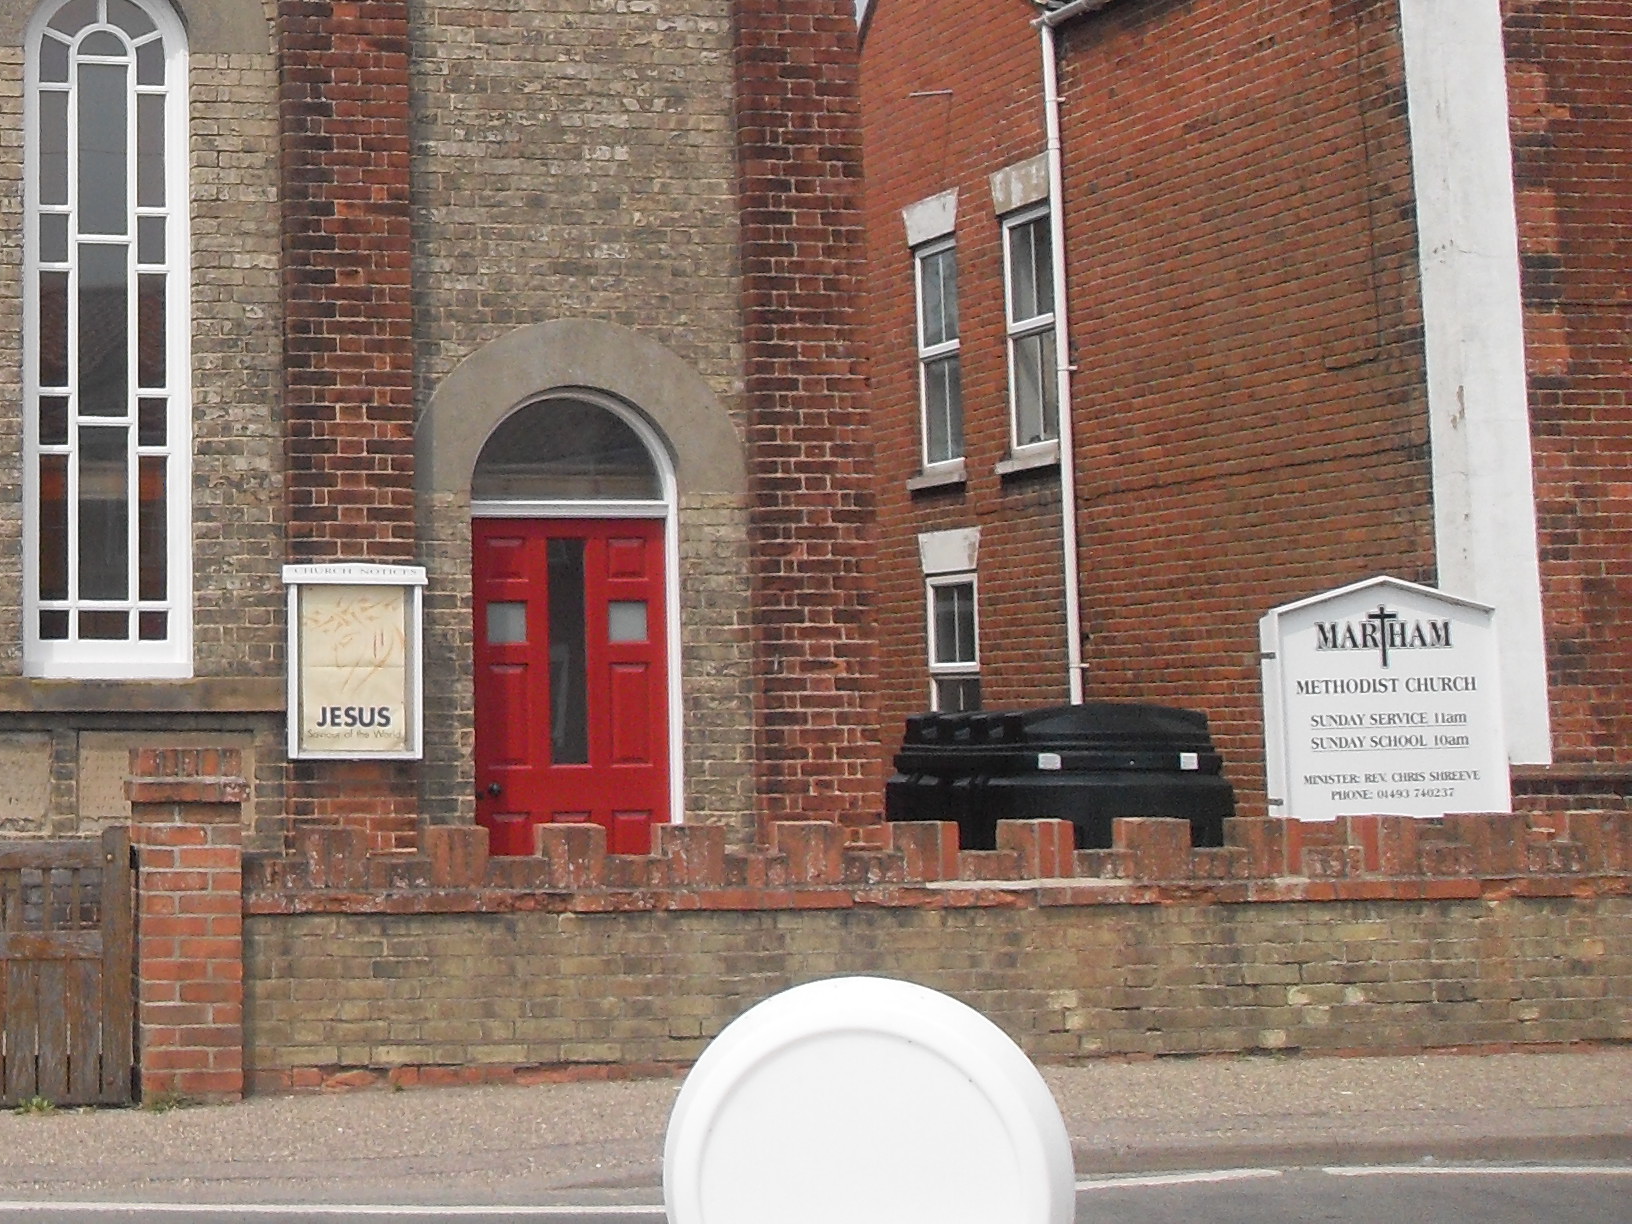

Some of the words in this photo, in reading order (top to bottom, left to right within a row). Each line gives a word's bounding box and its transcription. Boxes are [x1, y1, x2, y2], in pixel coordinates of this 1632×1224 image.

[294, 567, 352, 575] CHURCH
[360, 567, 418, 576] NOTICES
[1316, 606, 1452, 666] MARTHAM
[1296, 678, 1399, 695] METHODIST
[1405, 677, 1477, 693] CHURCH
[316, 706, 392, 728] JESUS
[1310, 714, 1365, 727] SUNDAY
[1370, 712, 1428, 726] SERVICE
[1434, 712, 1467, 724] 11am
[1310, 736, 1366, 750] SUNDAY
[1370, 735, 1428, 748] SCHOOL
[1434, 734, 1469, 746] 10am
[1391, 771, 1426, 783] CHRIS
[1331, 790, 1373, 801] PHONE:
